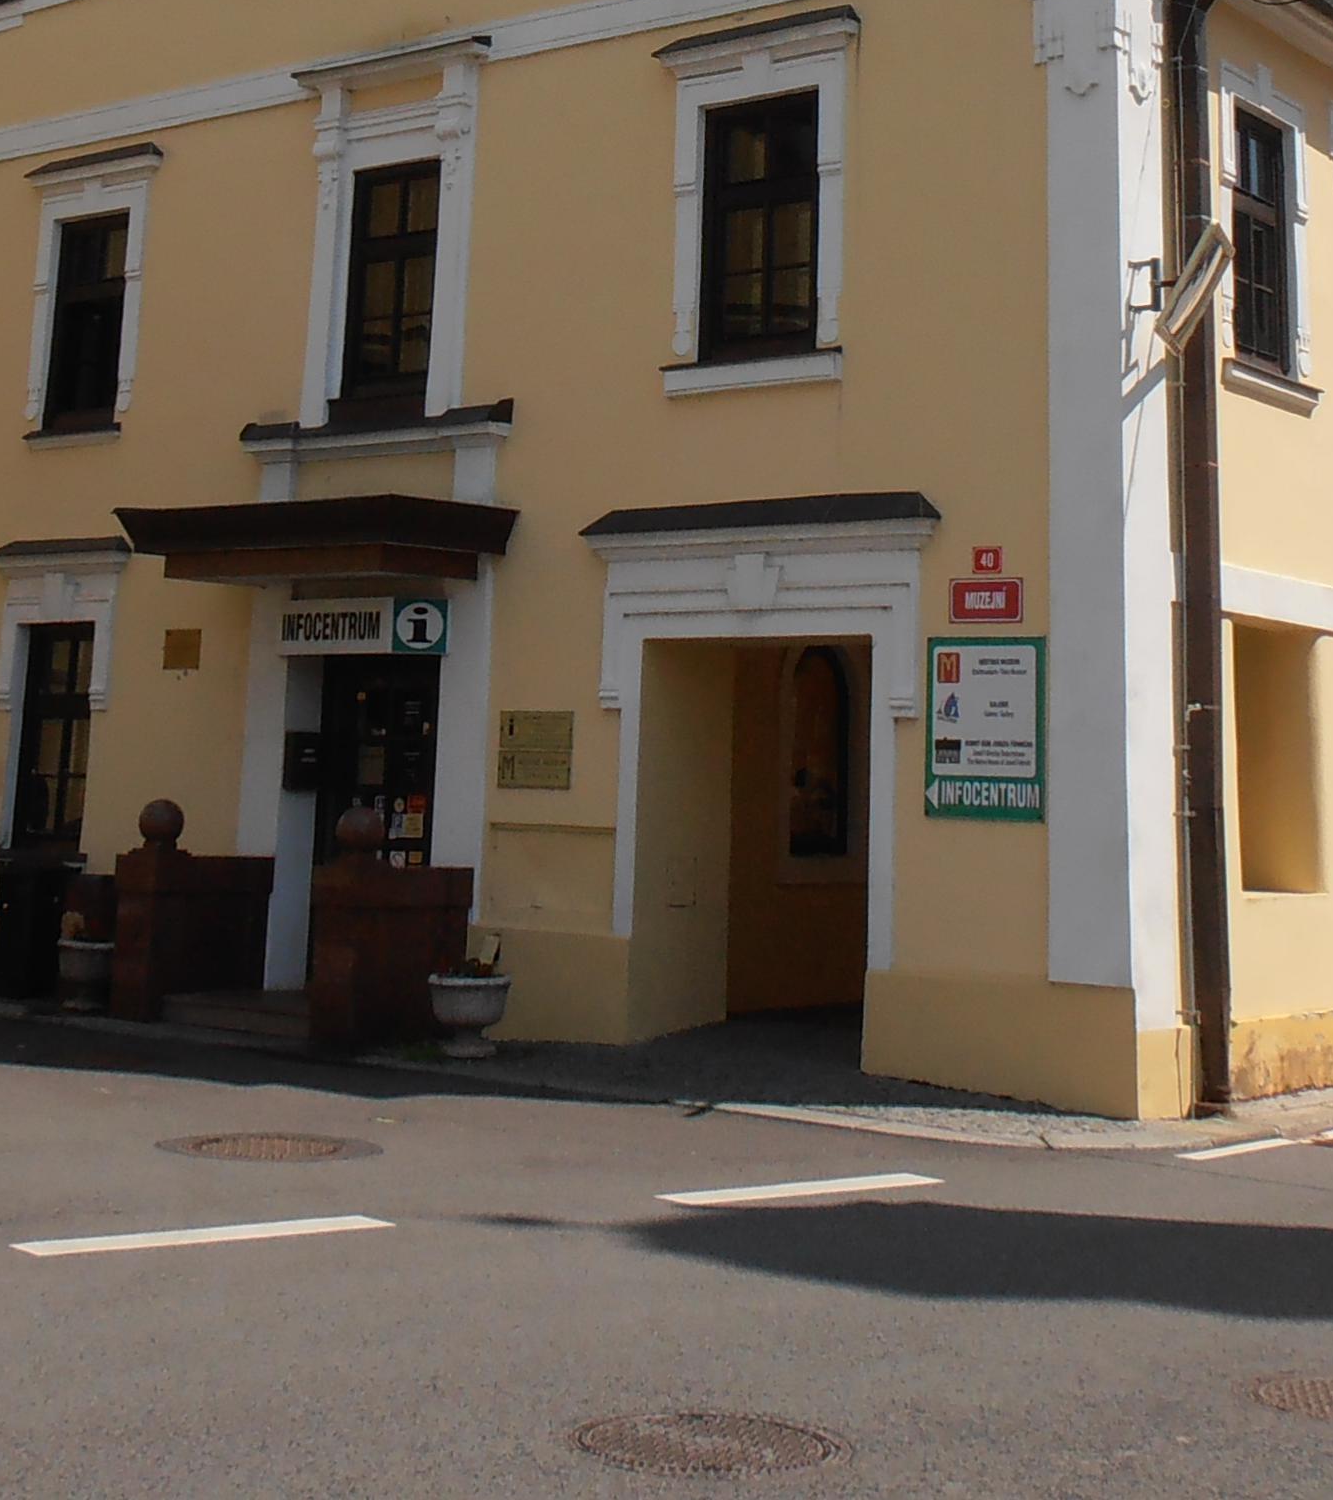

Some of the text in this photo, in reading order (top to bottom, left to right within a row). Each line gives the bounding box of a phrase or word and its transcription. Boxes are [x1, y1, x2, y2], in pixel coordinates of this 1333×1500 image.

[979, 552, 995, 569] 40
[281, 611, 381, 642] INFOCENTRUM
[941, 780, 1040, 809] INFOCENTRUM
